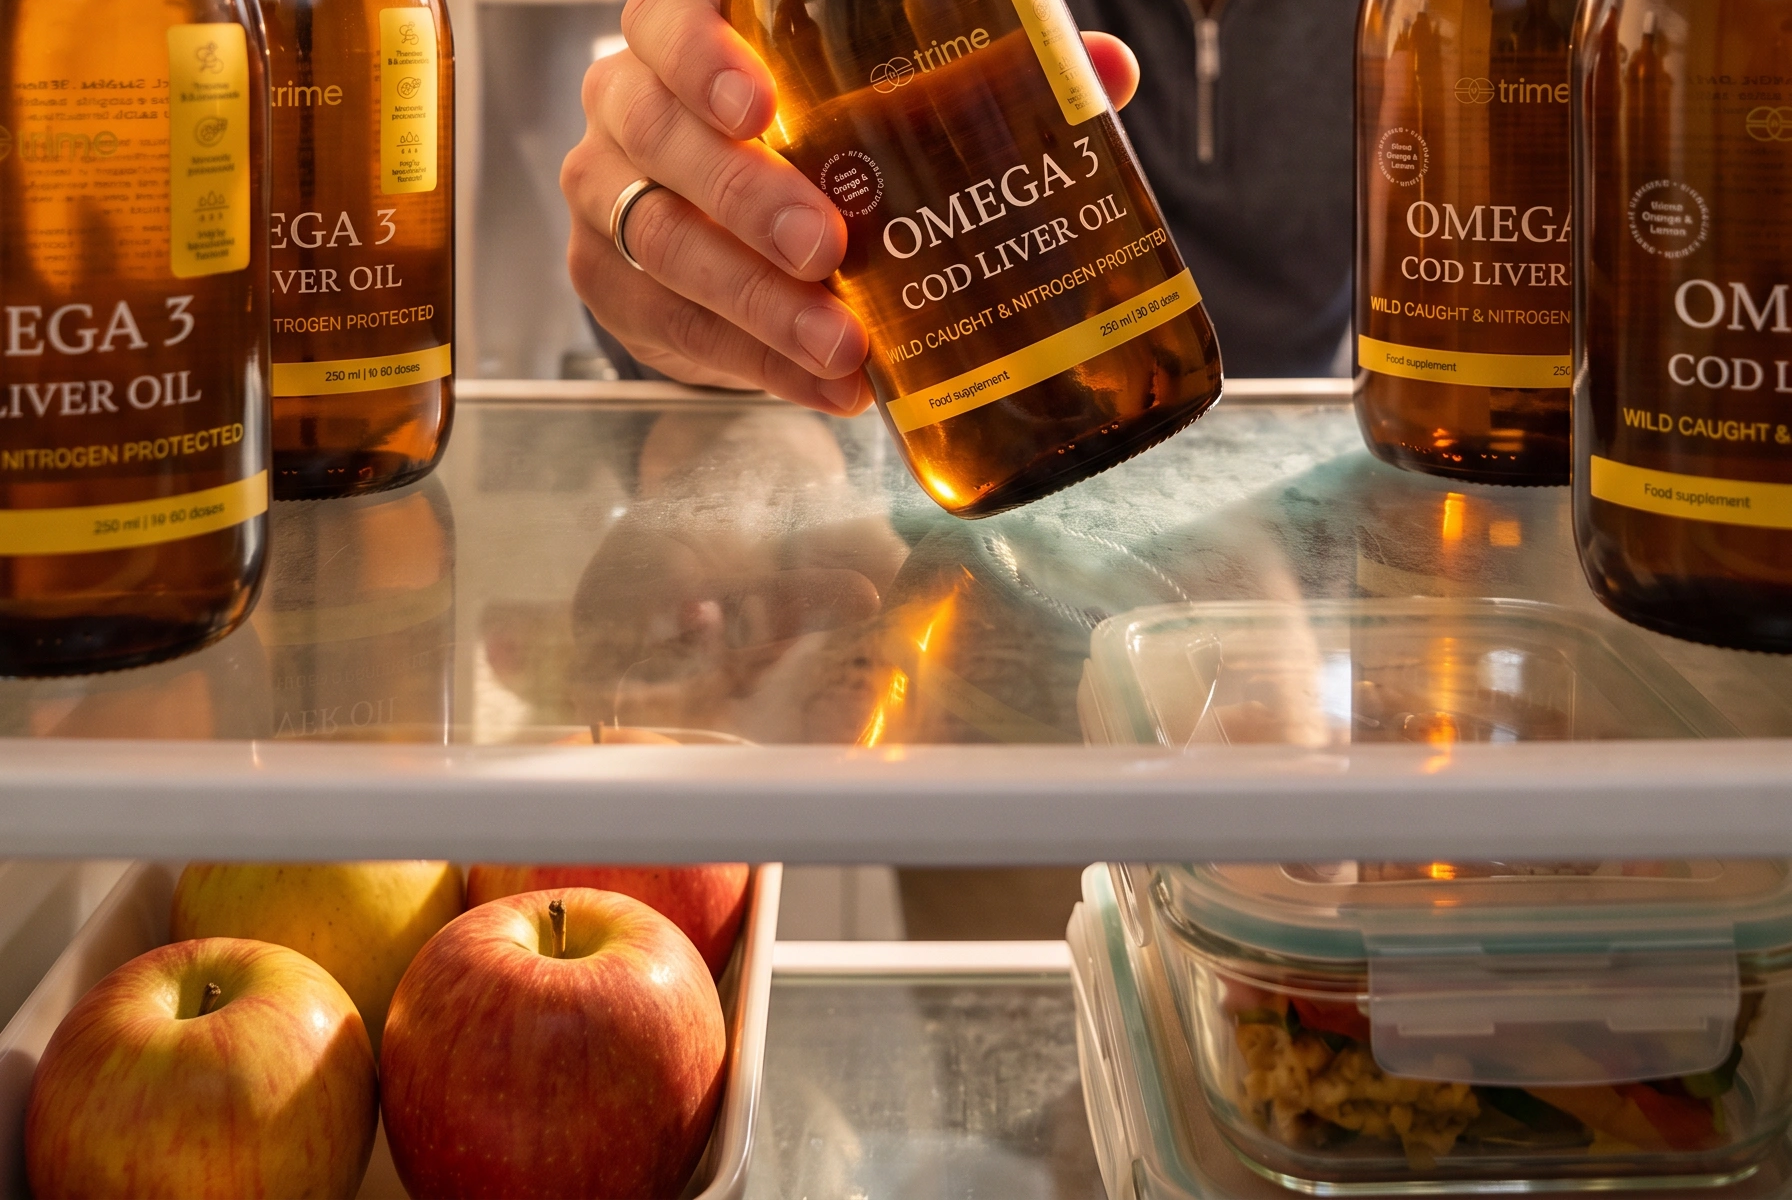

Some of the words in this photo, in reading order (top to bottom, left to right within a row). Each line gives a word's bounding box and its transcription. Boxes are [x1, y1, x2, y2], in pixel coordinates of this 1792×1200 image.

[913, 27, 990, 74] trime
[1498, 77, 1569, 103] trime
[883, 153, 1076, 259] OMEGA
[1073, 136, 1099, 178] 3
[375, 208, 397, 245] 3
[901, 263, 972, 310] COD
[975, 217, 1079, 280] LIVER
[1079, 193, 1128, 231] OIL
[271, 268, 341, 294] VER
[349, 264, 403, 291] OIL
[1401, 256, 1465, 284] COD
[1472, 261, 1572, 287] LIVER
[273, 316, 342, 333] TROGEN
[347, 304, 434, 330] PROTECTED
[886, 339, 923, 365] WILD
[925, 307, 994, 350] CAUGHT
[996, 302, 1013, 319] &
[1011, 263, 1098, 312] NITROGEN
[1370, 295, 1400, 315] WILD
[1404, 302, 1470, 322] CAUGHT
[1472, 308, 1484, 323] &
[1488, 309, 1571, 326] NITROGEN
[1674, 279, 1792, 333] OM
[4, 300, 148, 356] EGA
[164, 294, 195, 347] 3
[325, 371, 345, 382] 250
[347, 369, 361, 380] ml
[394, 363, 420, 375] doses
[1386, 353, 1404, 366] Food
[1406, 357, 1457, 373] supplement
[1667, 353, 1764, 392] COD
[126, 370, 202, 410] OIL
[928, 392, 953, 409] Food
[1623, 407, 1673, 433] WILD
[1678, 416, 1770, 442] CAUGHT
[2, 444, 118, 470] NITROGEN
[123, 422, 244, 463] PROTECTED
[1644, 483, 1673, 500] Food
[1675, 490, 1751, 509] supplement
